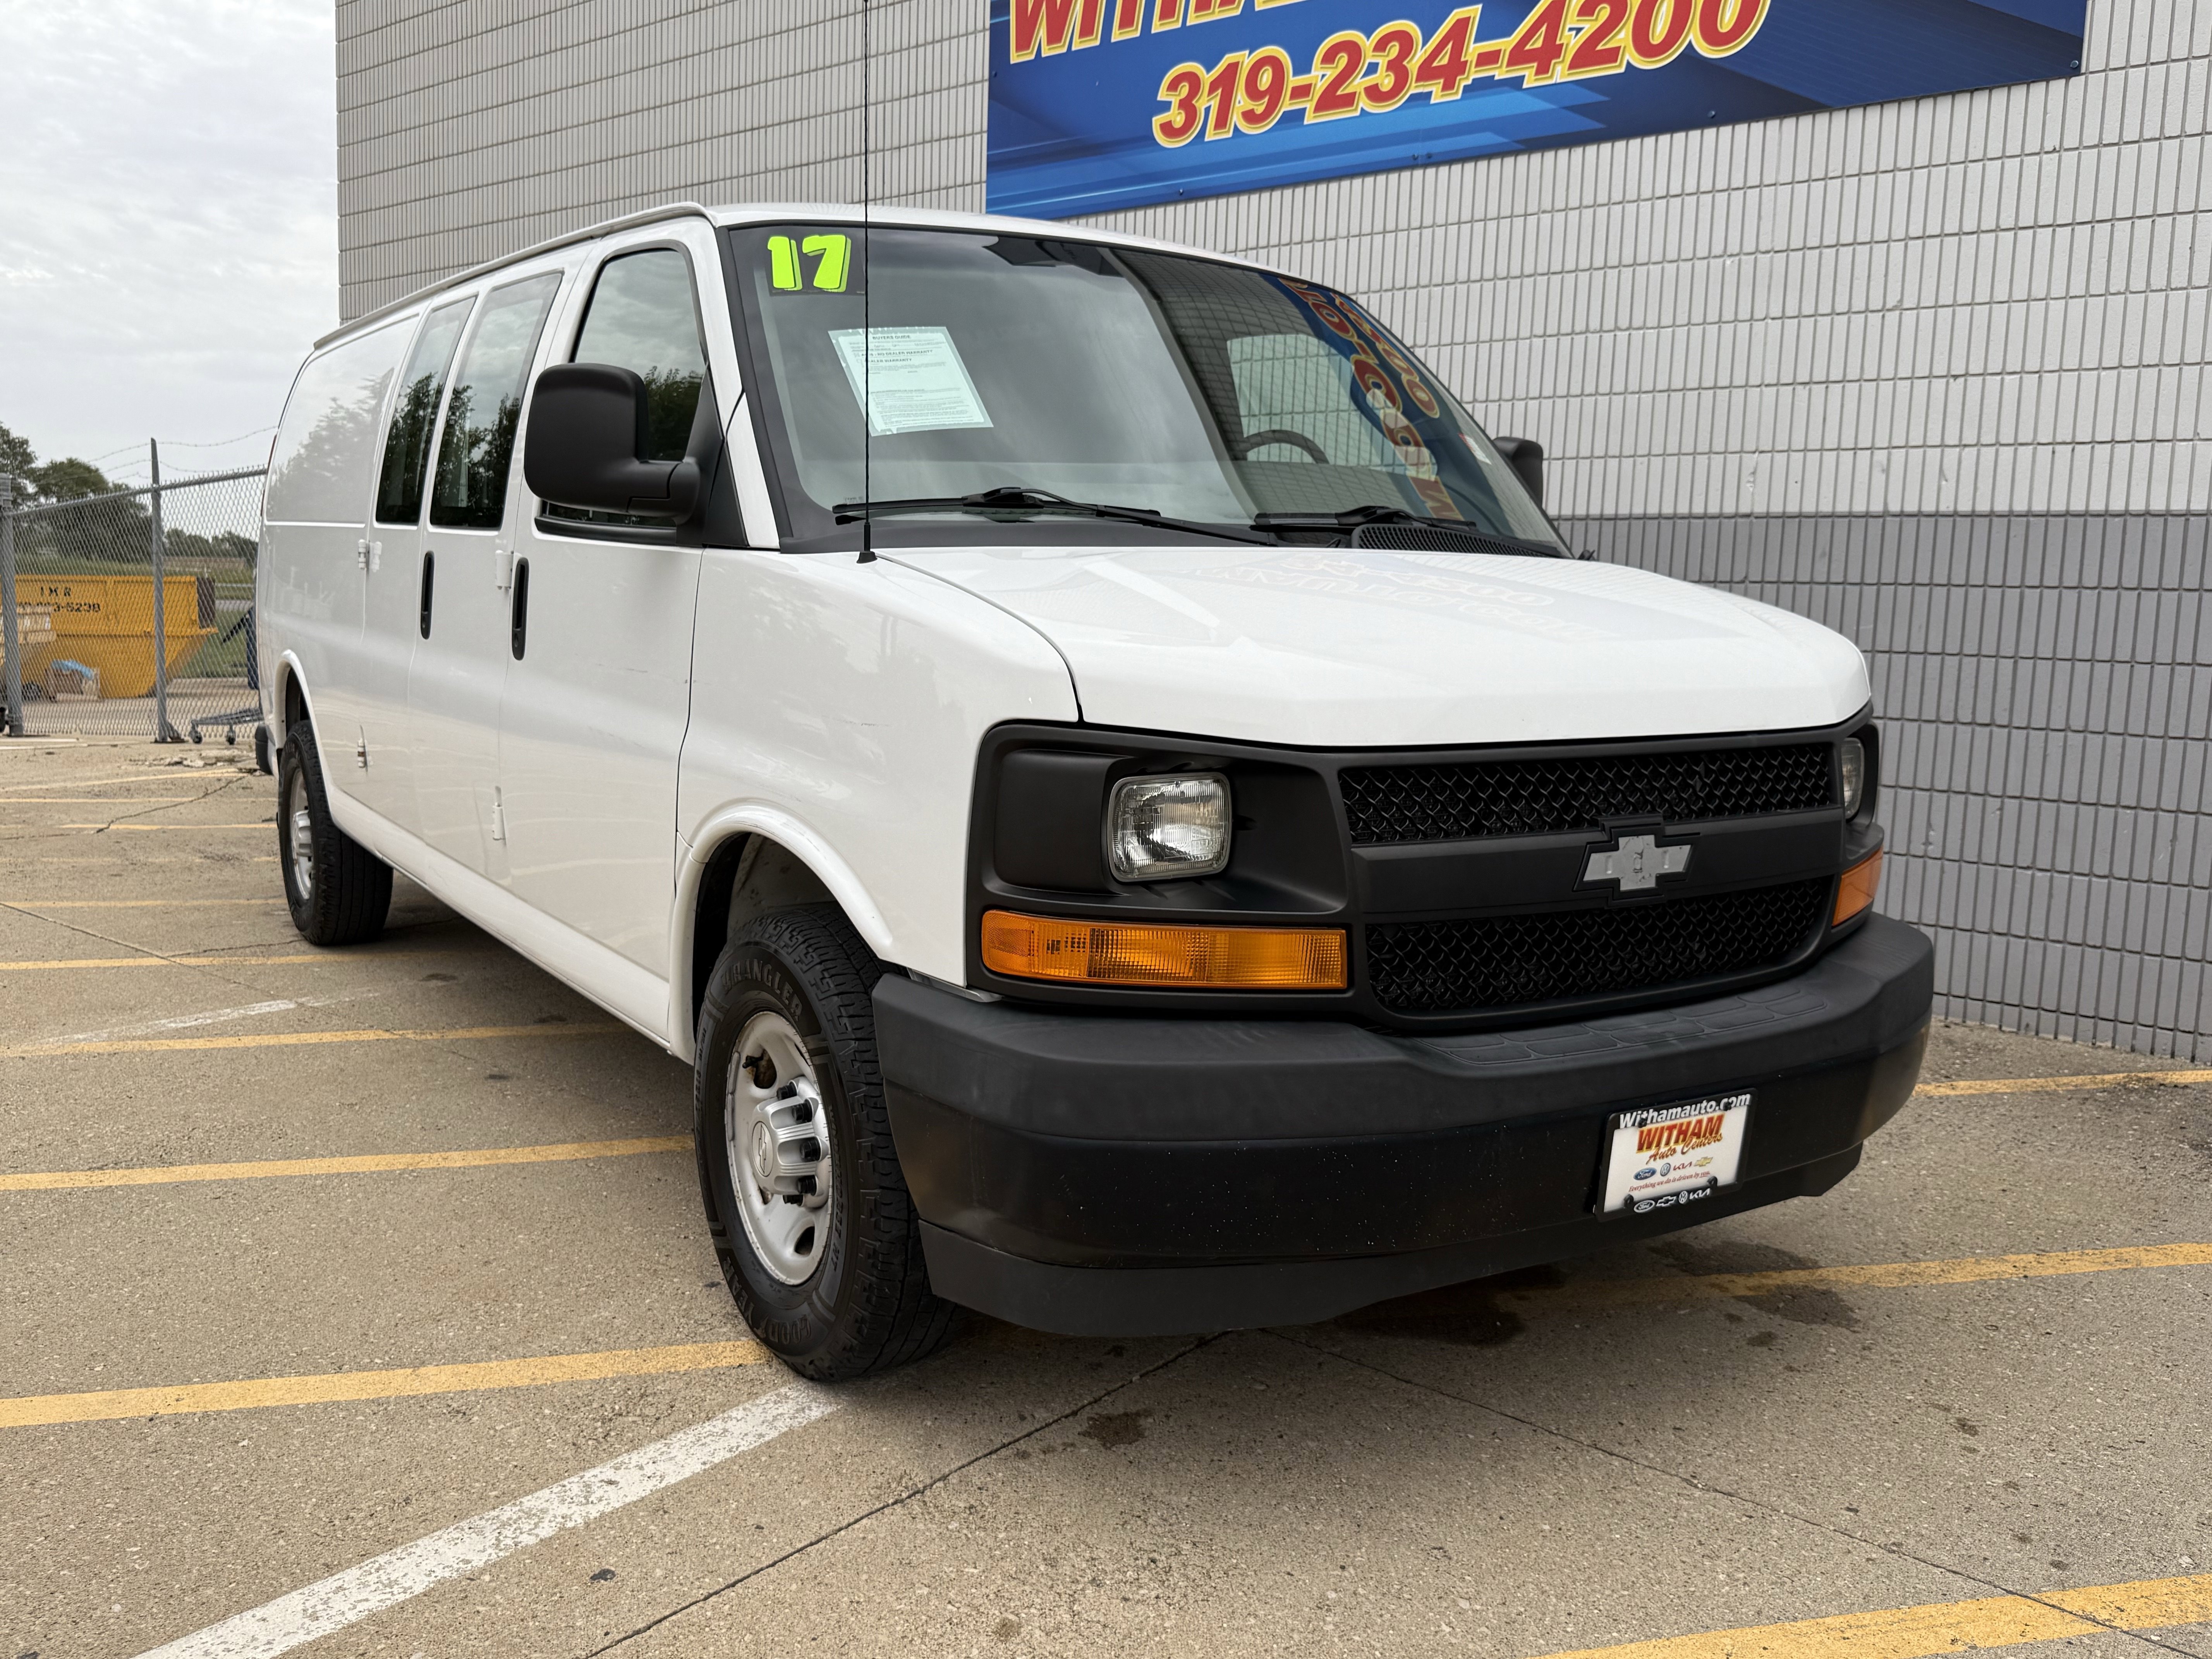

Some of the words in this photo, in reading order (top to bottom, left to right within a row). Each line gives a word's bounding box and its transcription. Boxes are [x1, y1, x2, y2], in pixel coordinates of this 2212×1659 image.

[1152, 0, 1771, 148] 319-234-4200
[768, 235, 851, 292] 17
[1636, 1113, 1725, 1154] WITHAM
[1646, 1145, 1677, 1164] Auto
[1681, 1132, 1723, 1155] Centers
[1628, 1181, 1656, 1192] Everything
